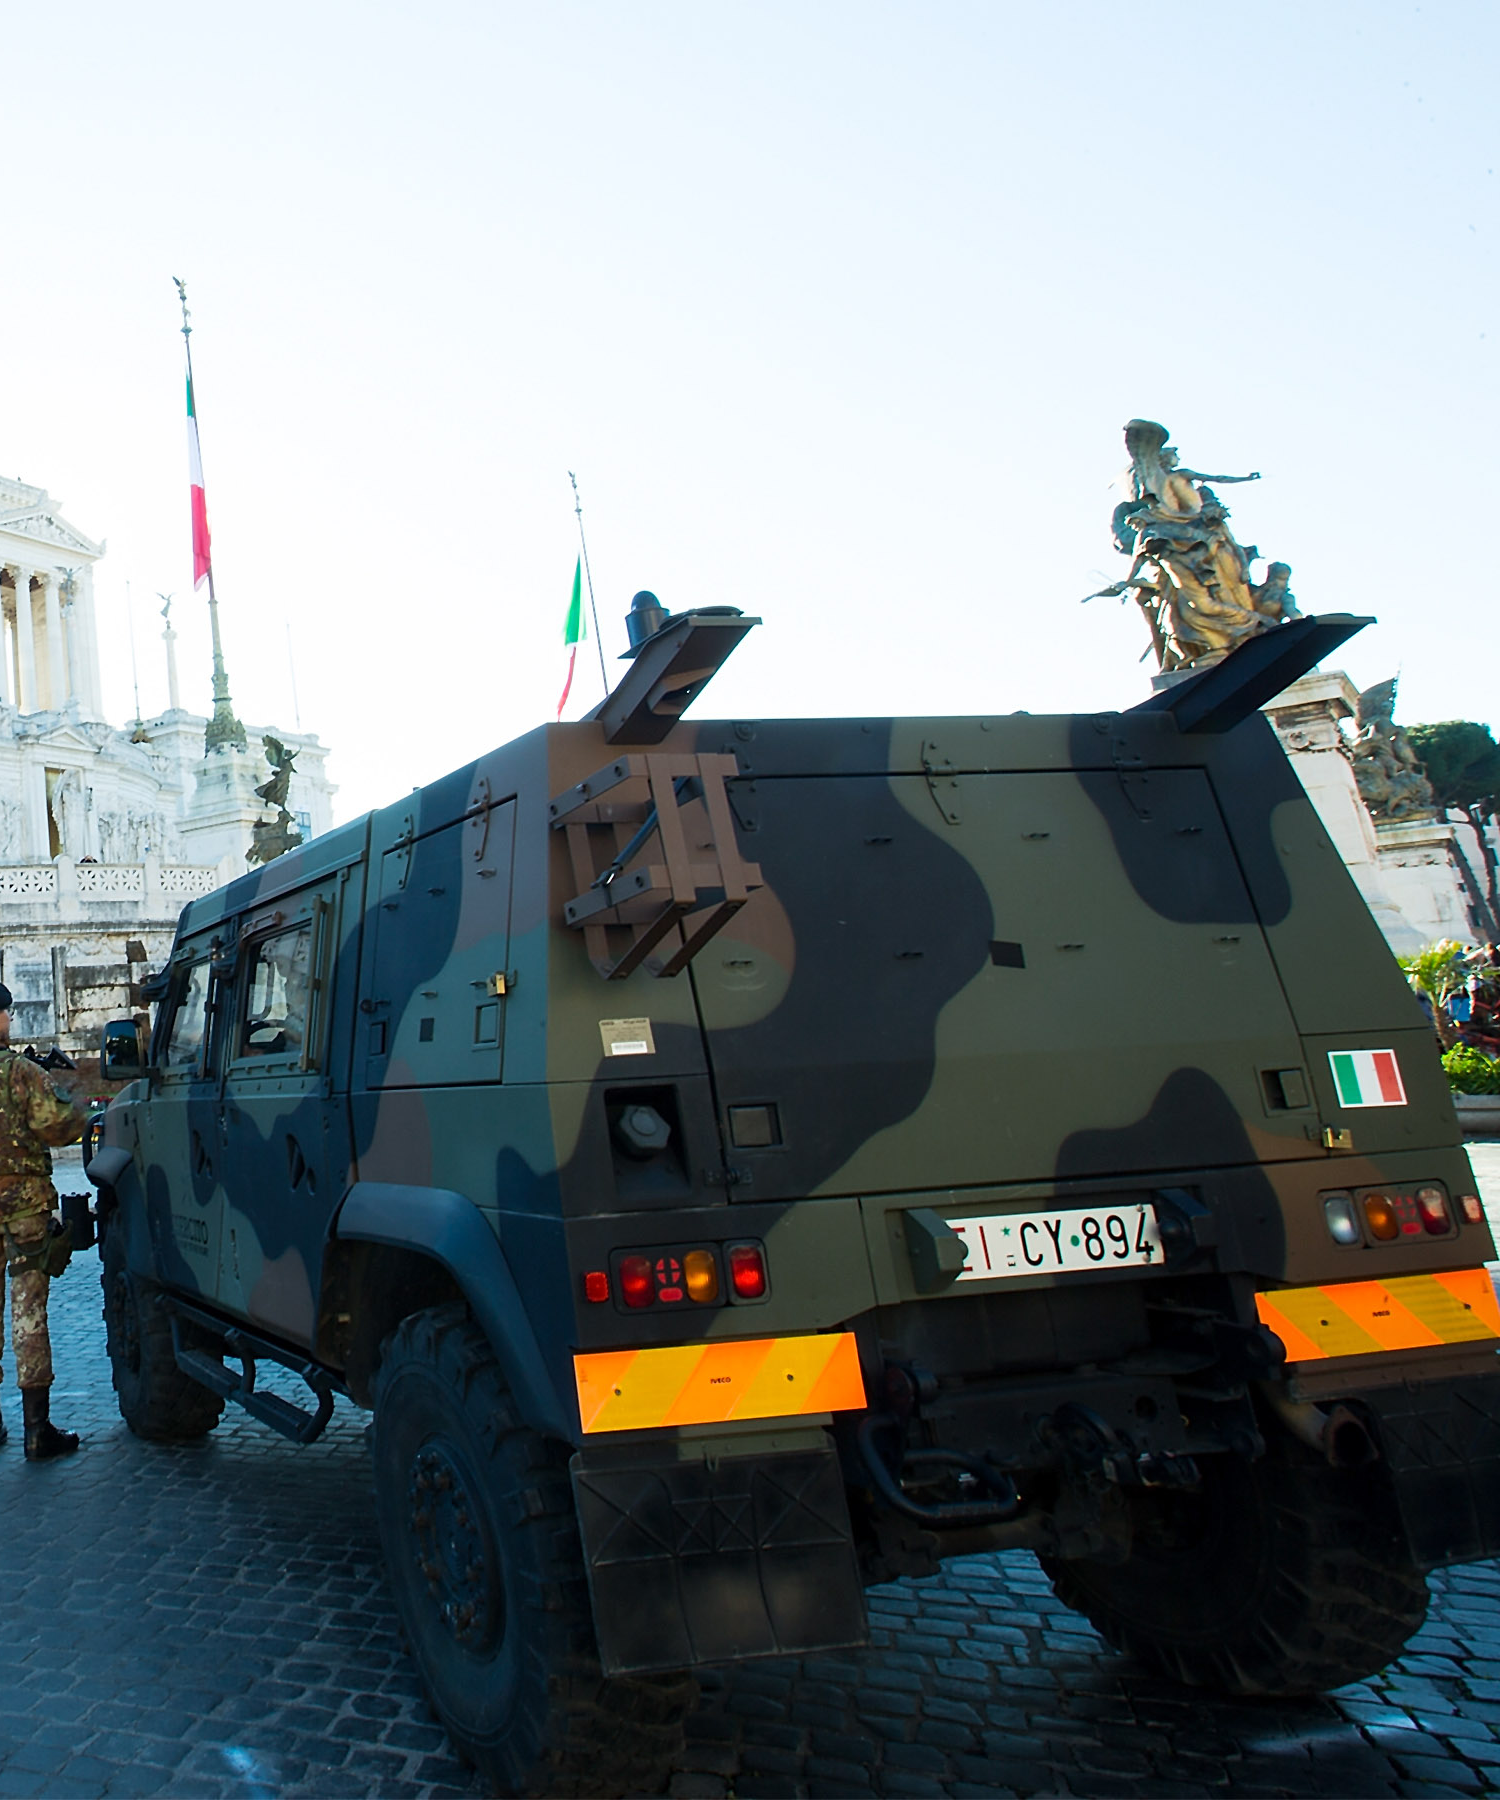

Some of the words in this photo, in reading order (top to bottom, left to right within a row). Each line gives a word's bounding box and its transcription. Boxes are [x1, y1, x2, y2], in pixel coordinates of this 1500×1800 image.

[1020, 1219, 1063, 1267] CY
[1081, 1211, 1154, 1262] 894
[710, 1376, 731, 1384] IVECO
